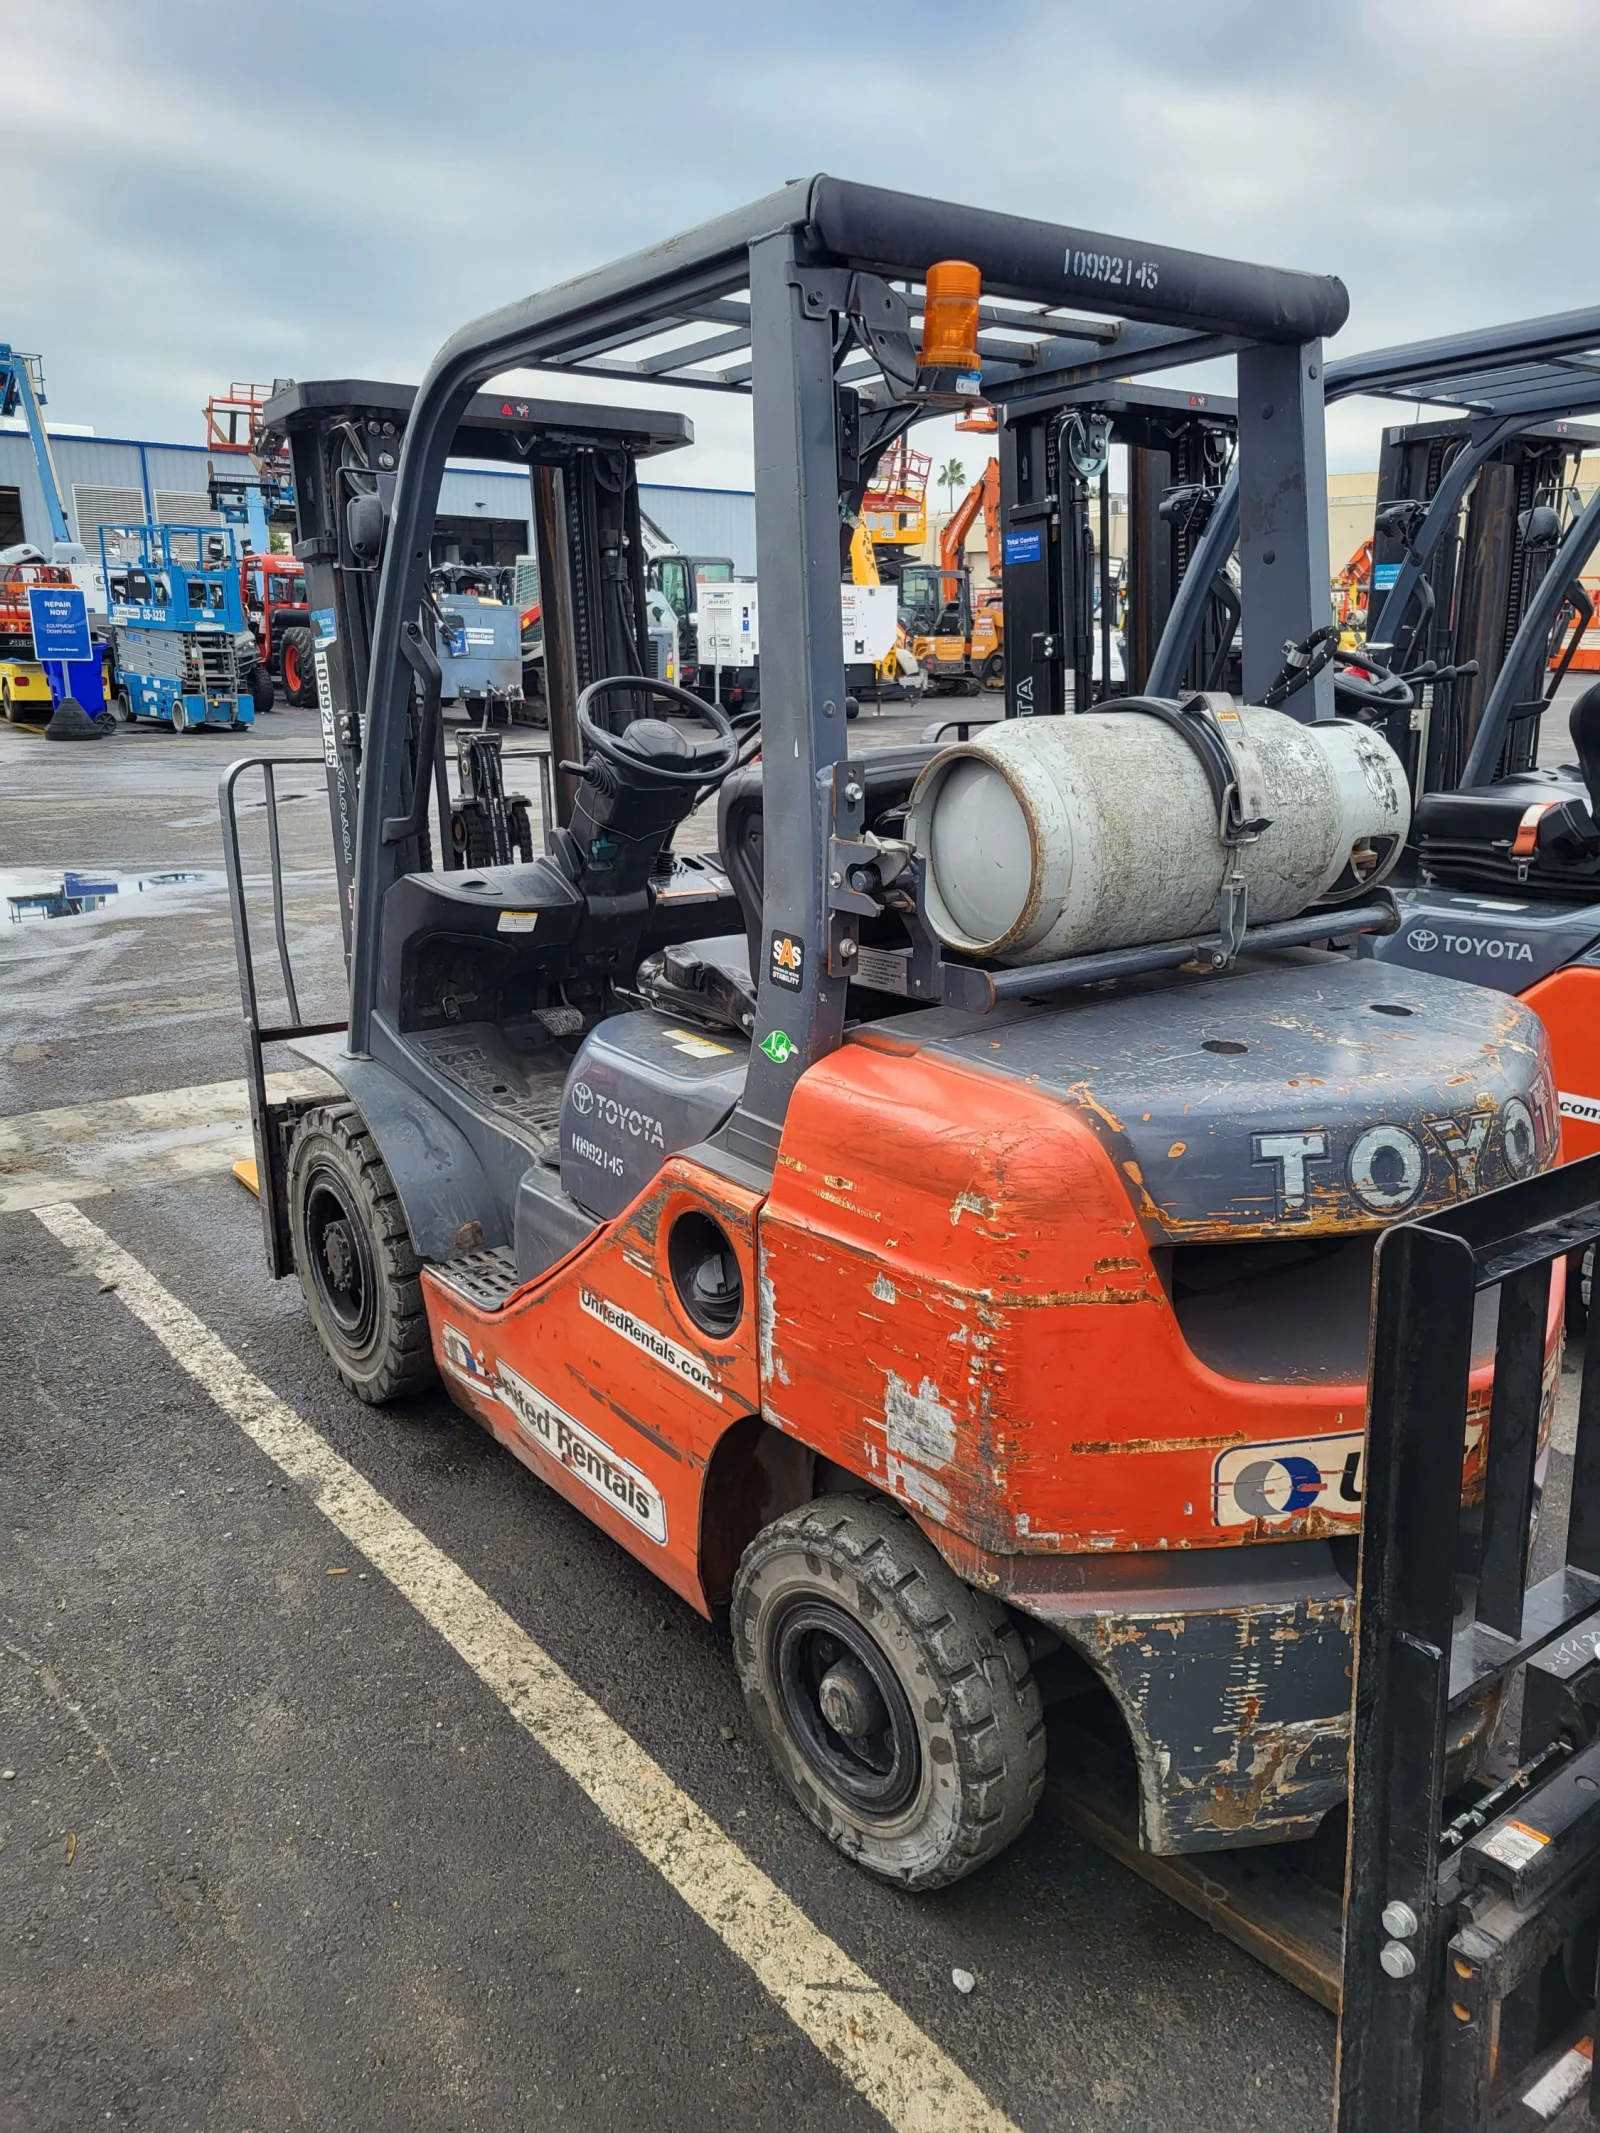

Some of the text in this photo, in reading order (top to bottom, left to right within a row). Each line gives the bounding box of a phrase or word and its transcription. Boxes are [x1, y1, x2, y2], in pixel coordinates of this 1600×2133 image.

[1063, 248, 1159, 290] 10992145
[1006, 536, 1039, 546] Total Control
[142, 608, 166, 622] GS-3232
[316, 655, 338, 767] 10992145
[336, 756, 353, 864] TOYOTA
[772, 938, 802, 970] SAS
[1442, 934, 1534, 963] TOYOTA
[772, 971, 800, 986] STABILITY
[596, 1093, 665, 1149] TOYOTA
[572, 1132, 624, 1176] 10992145
[556, 1418, 650, 1520] Rentals
